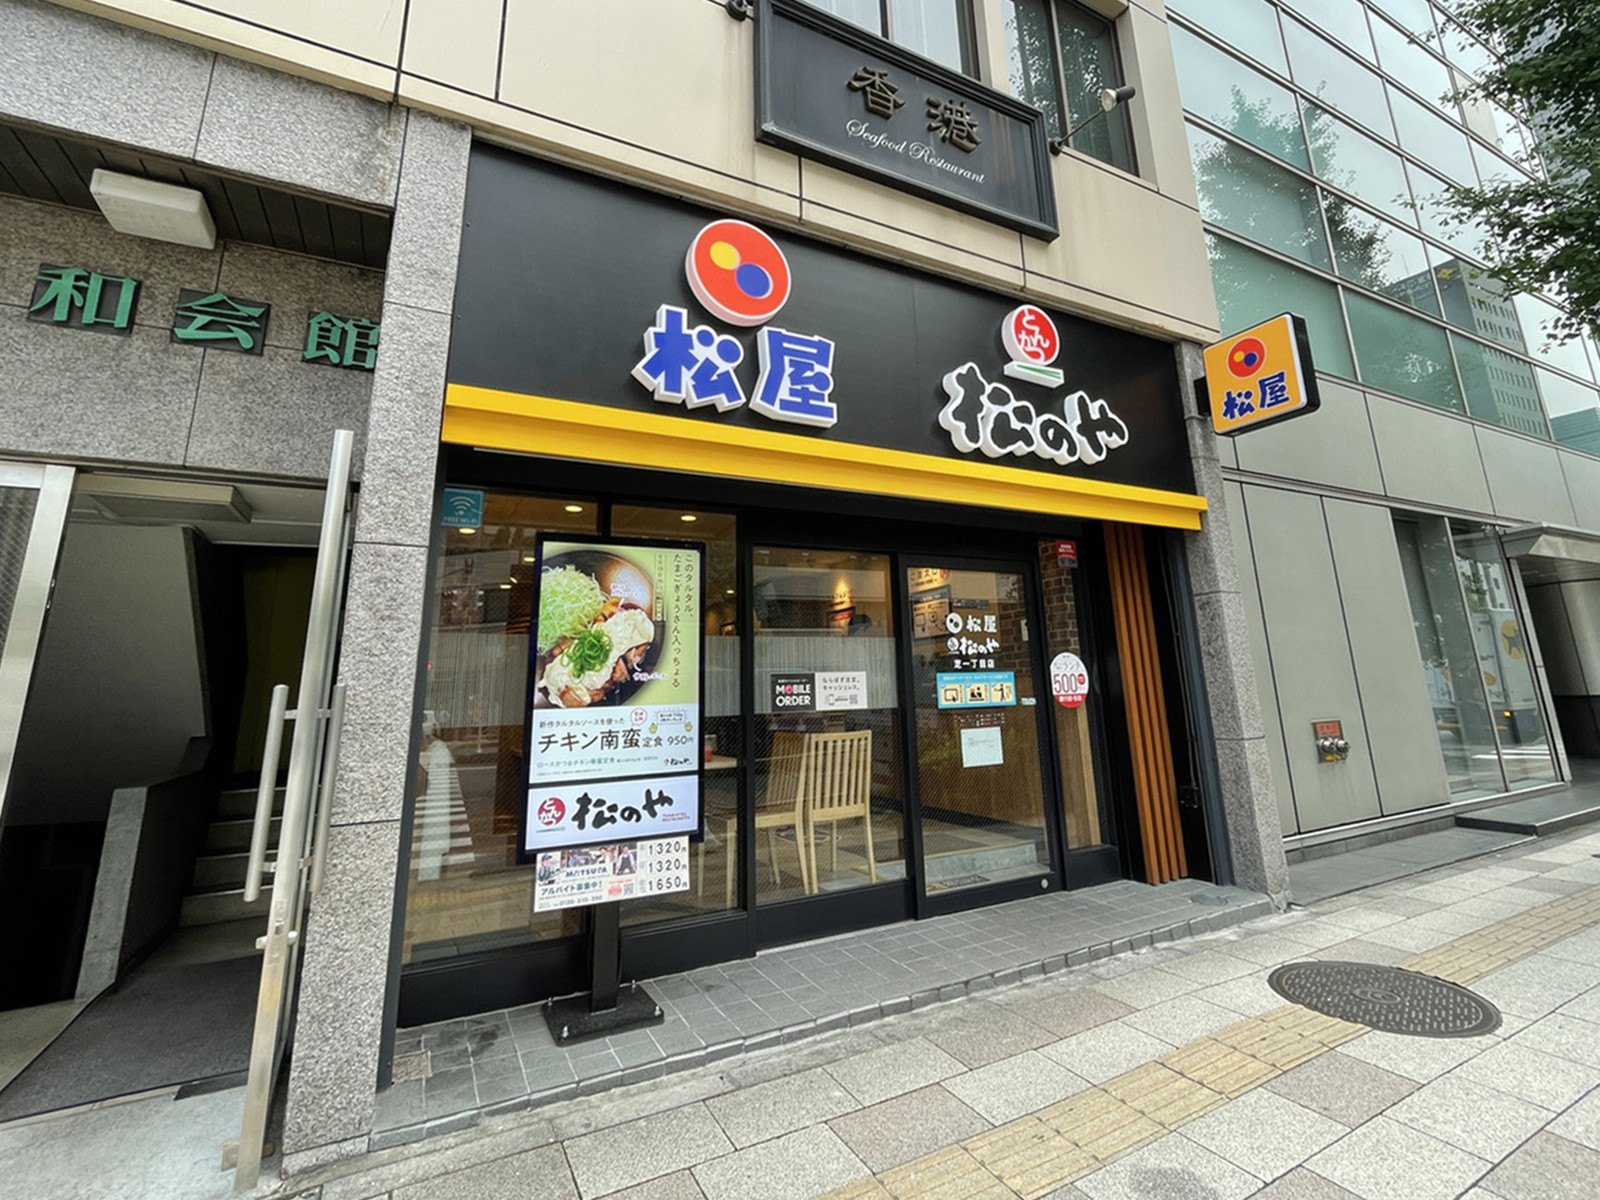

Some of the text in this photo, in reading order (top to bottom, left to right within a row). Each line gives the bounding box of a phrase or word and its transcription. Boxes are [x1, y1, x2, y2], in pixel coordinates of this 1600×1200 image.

[846, 65, 982, 154] 香港
[845, 119, 986, 184] Seafood Restaurant
[632, 303, 837, 428] 松屋
[1222, 371, 1290, 420] 松屋
[938, 362, 1129, 466] 松のや
[966, 615, 998, 633] 松屋
[960, 636, 1000, 656] 松のや
[775, 684, 811, 695] MOBILE
[1053, 673, 1079, 694] 500
[775, 695, 811, 707] ORDER
[538, 728, 664, 753] チキン南蛮定食
[571, 788, 674, 831] 松のや
